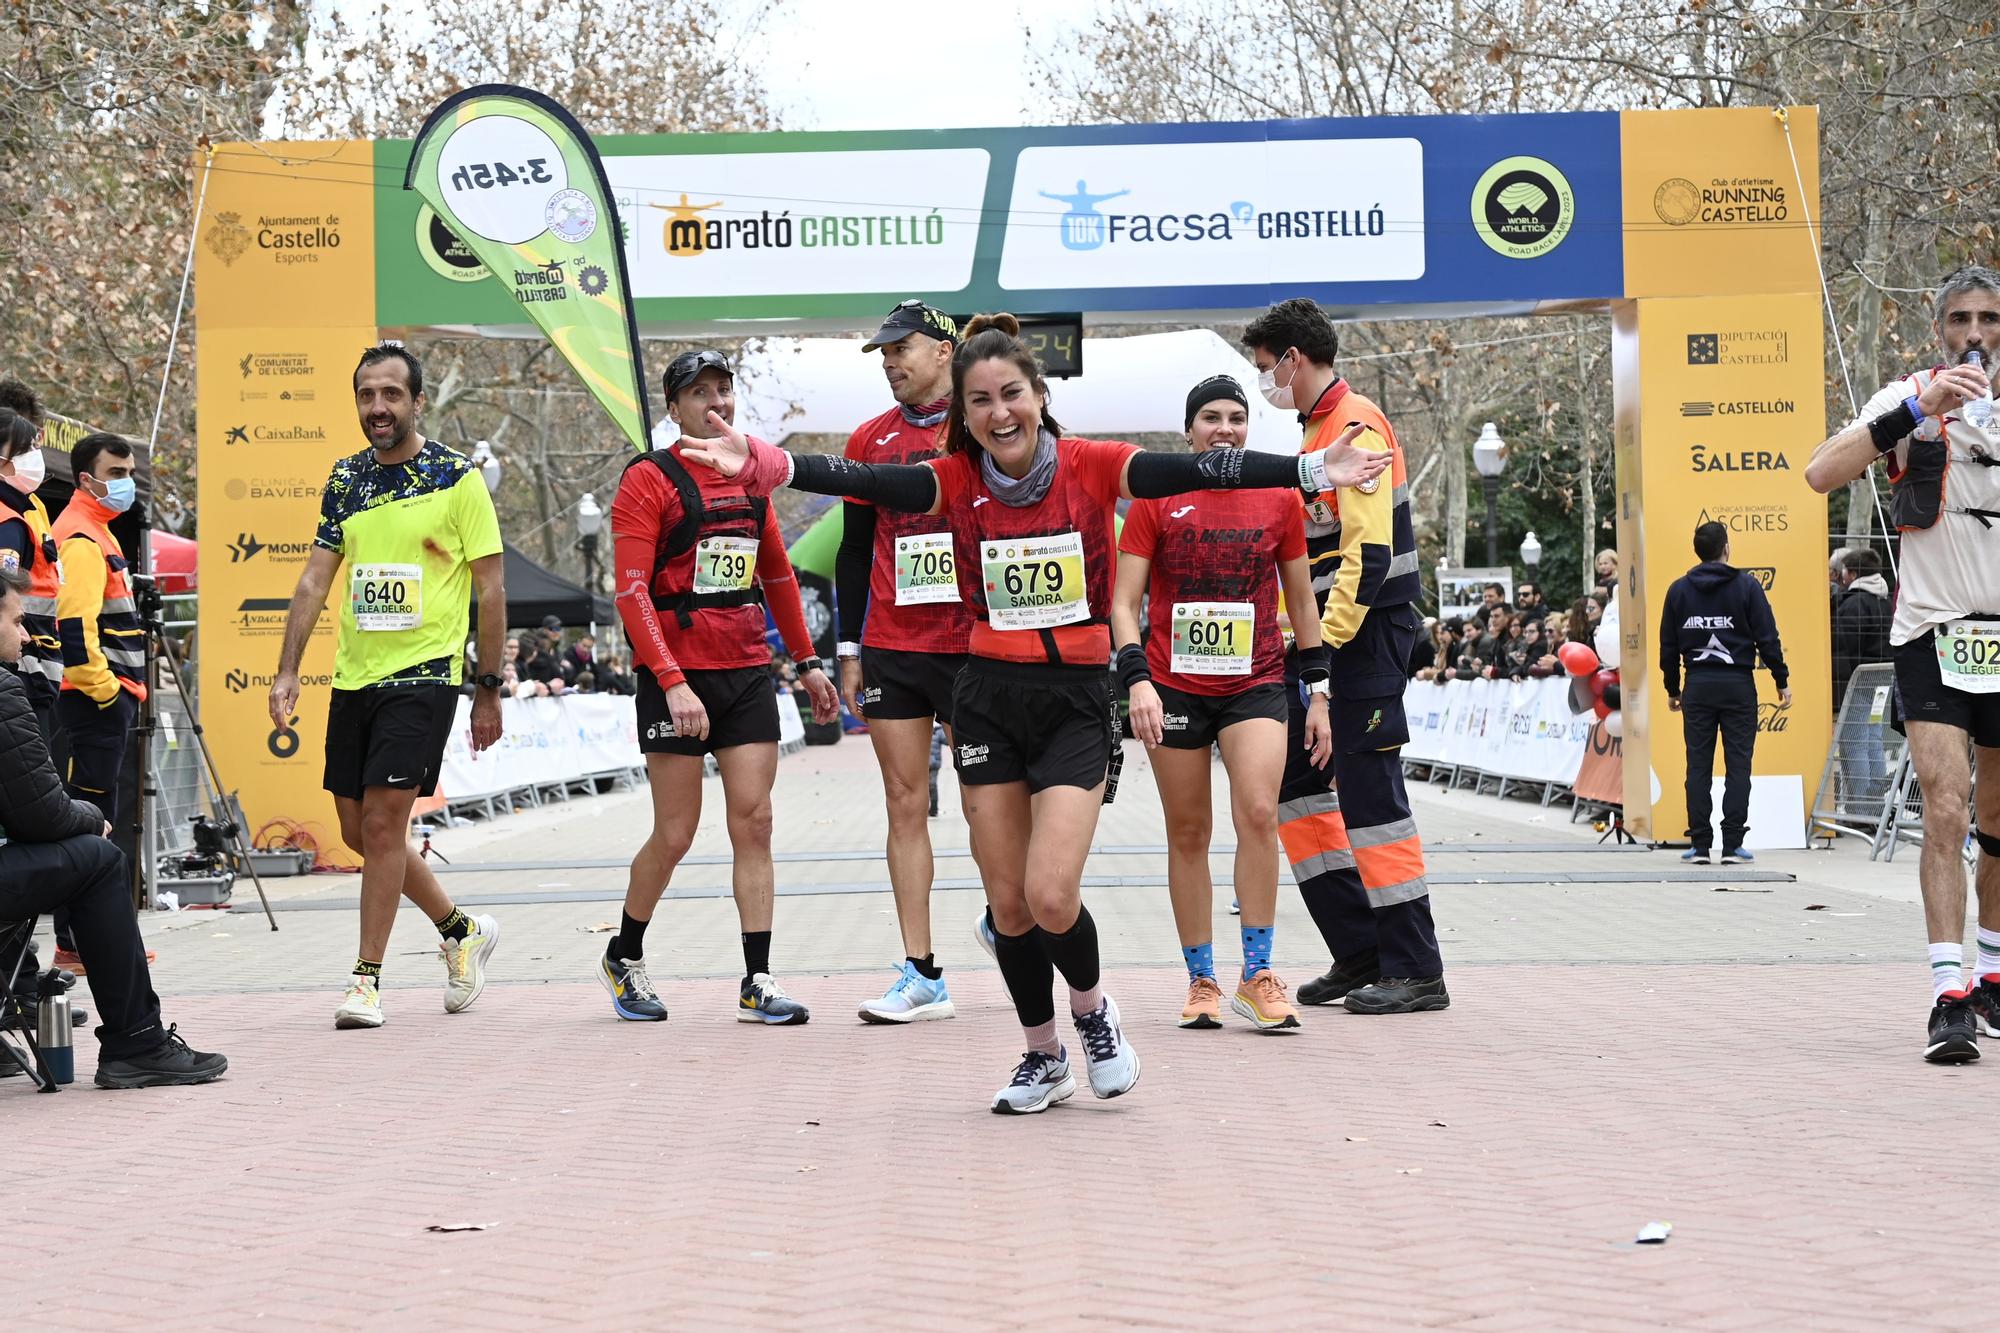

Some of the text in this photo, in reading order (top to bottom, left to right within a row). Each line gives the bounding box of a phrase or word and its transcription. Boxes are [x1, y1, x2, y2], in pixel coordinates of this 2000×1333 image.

[1711, 178, 1728, 187] Club
[1702, 187, 1785, 204] RUNNING
[1701, 200, 1788, 222] CASTELLÓ
[257, 214, 340, 228] Ajuntament de
[670, 207, 944, 251] marató CASTELLÓ
[1066, 216, 1101, 244] 10K
[1109, 212, 1233, 244] Facsa
[1257, 203, 1384, 240] CASTELLÓ
[1501, 224, 1546, 233] ATHLETICS
[1507, 217, 1539, 225] WORLD
[1507, 191, 1571, 255] ROAD RACE LABEL 2023
[257, 228, 341, 249] Castelló
[275, 251, 319, 265] Esports
[444, 248, 472, 256] ATHLE
[1720, 329, 1784, 342] DIPUTACIÓ
[254, 358, 308, 367] COMUNITAT
[1720, 352, 1784, 365] CASTELLÓ
[258, 366, 315, 376] DE L'ESPORT
[1718, 397, 1795, 415] CASTELLÓN
[253, 424, 326, 441] CaixaBank
[1691, 450, 1790, 473] SALERA
[1695, 507, 1789, 533] ASCIRES
[709, 554, 746, 579] 739
[910, 551, 953, 577] 706
[718, 579, 738, 588] JUAN
[910, 575, 954, 587] ALFONSO
[1004, 560, 1064, 595] 679
[364, 581, 406, 605] 640
[1011, 593, 1064, 608] SANDRA
[357, 604, 413, 614] ELEA DELRO
[1682, 615, 1735, 630] AIRTEK
[1188, 620, 1233, 646] 601
[1188, 646, 1236, 656] P.ABELLA
[1953, 639, 2000, 665] 802
